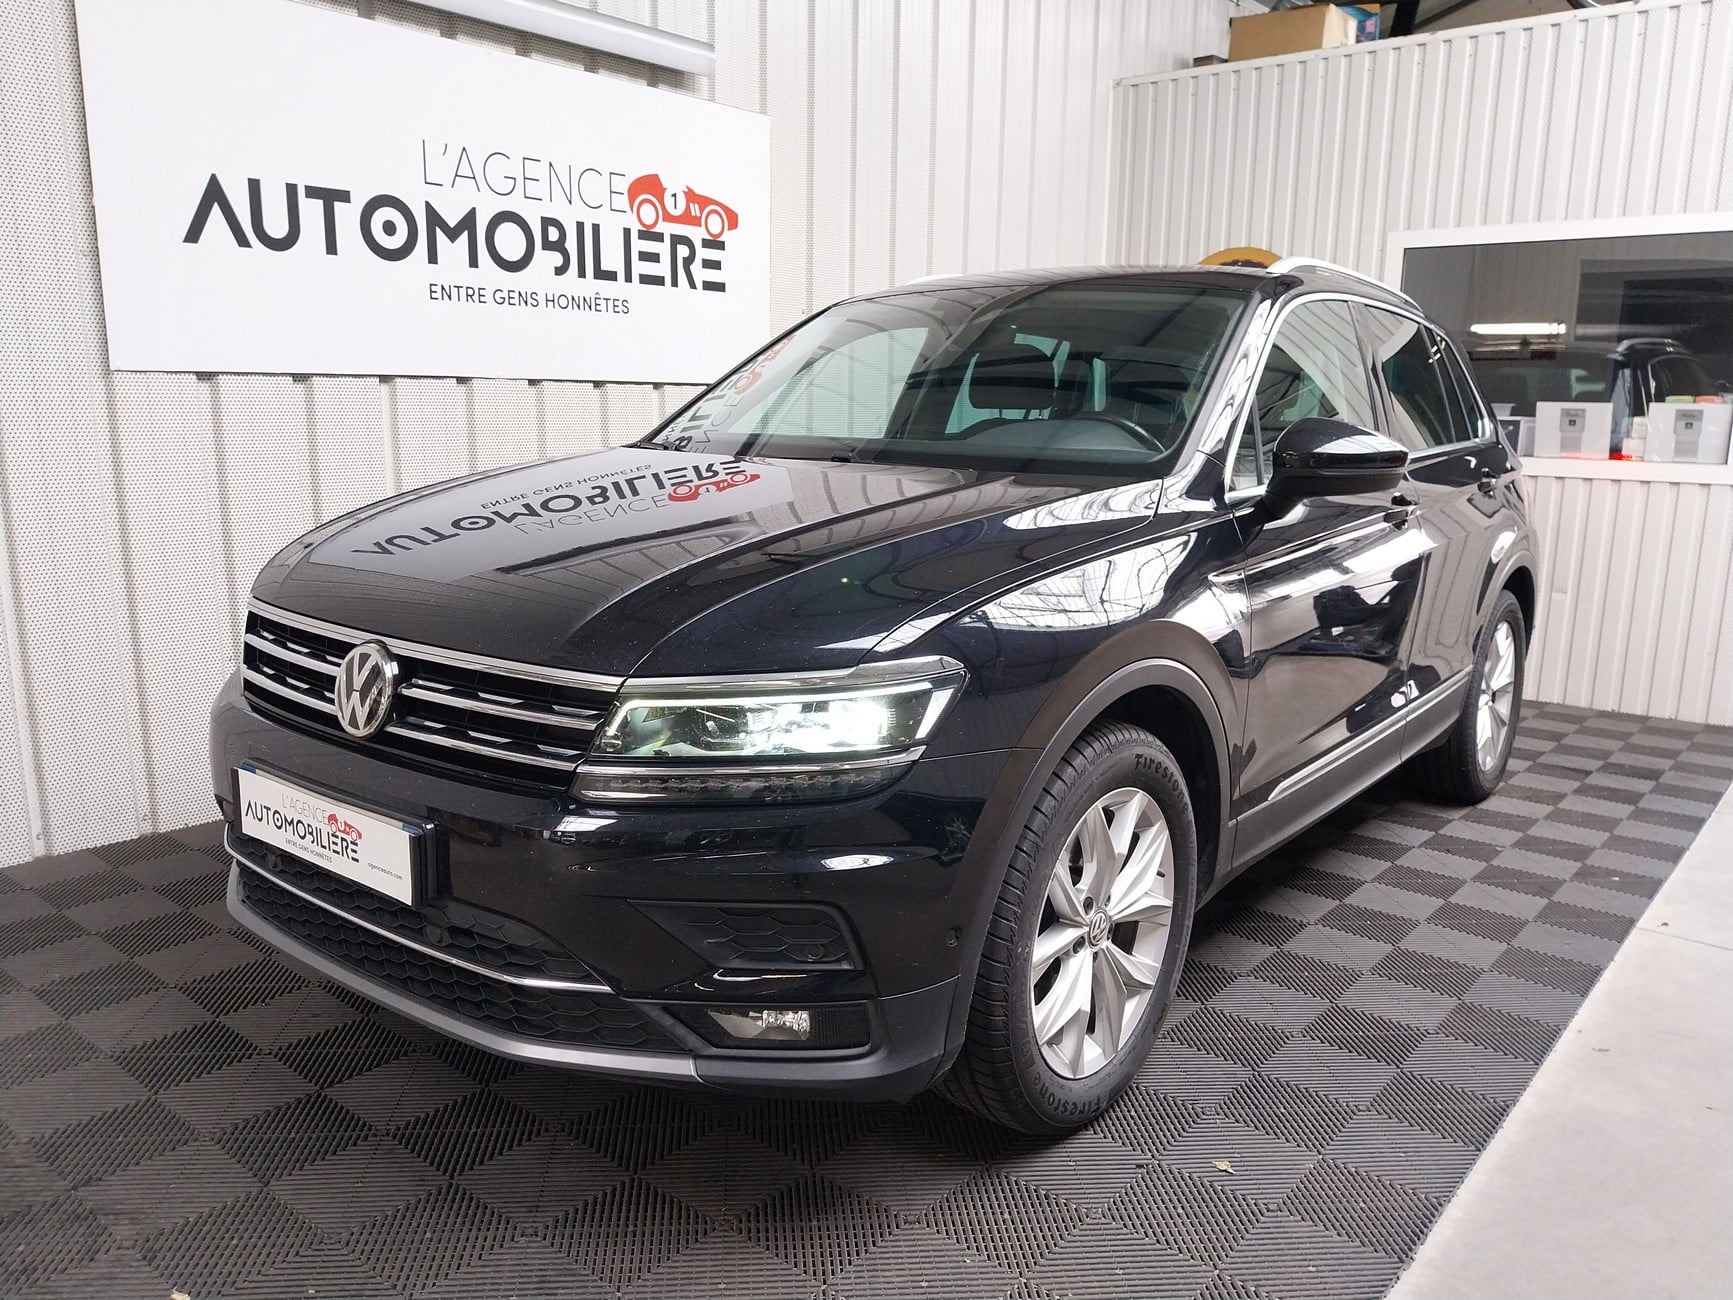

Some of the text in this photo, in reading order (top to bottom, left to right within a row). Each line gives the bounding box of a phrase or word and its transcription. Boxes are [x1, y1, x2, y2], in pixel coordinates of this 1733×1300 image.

[422, 139, 628, 214] L'AGENCE
[670, 192, 678, 210] 1
[428, 282, 630, 315] ENTRE GENS HONNÊTES
[335, 643, 393, 738] VW
